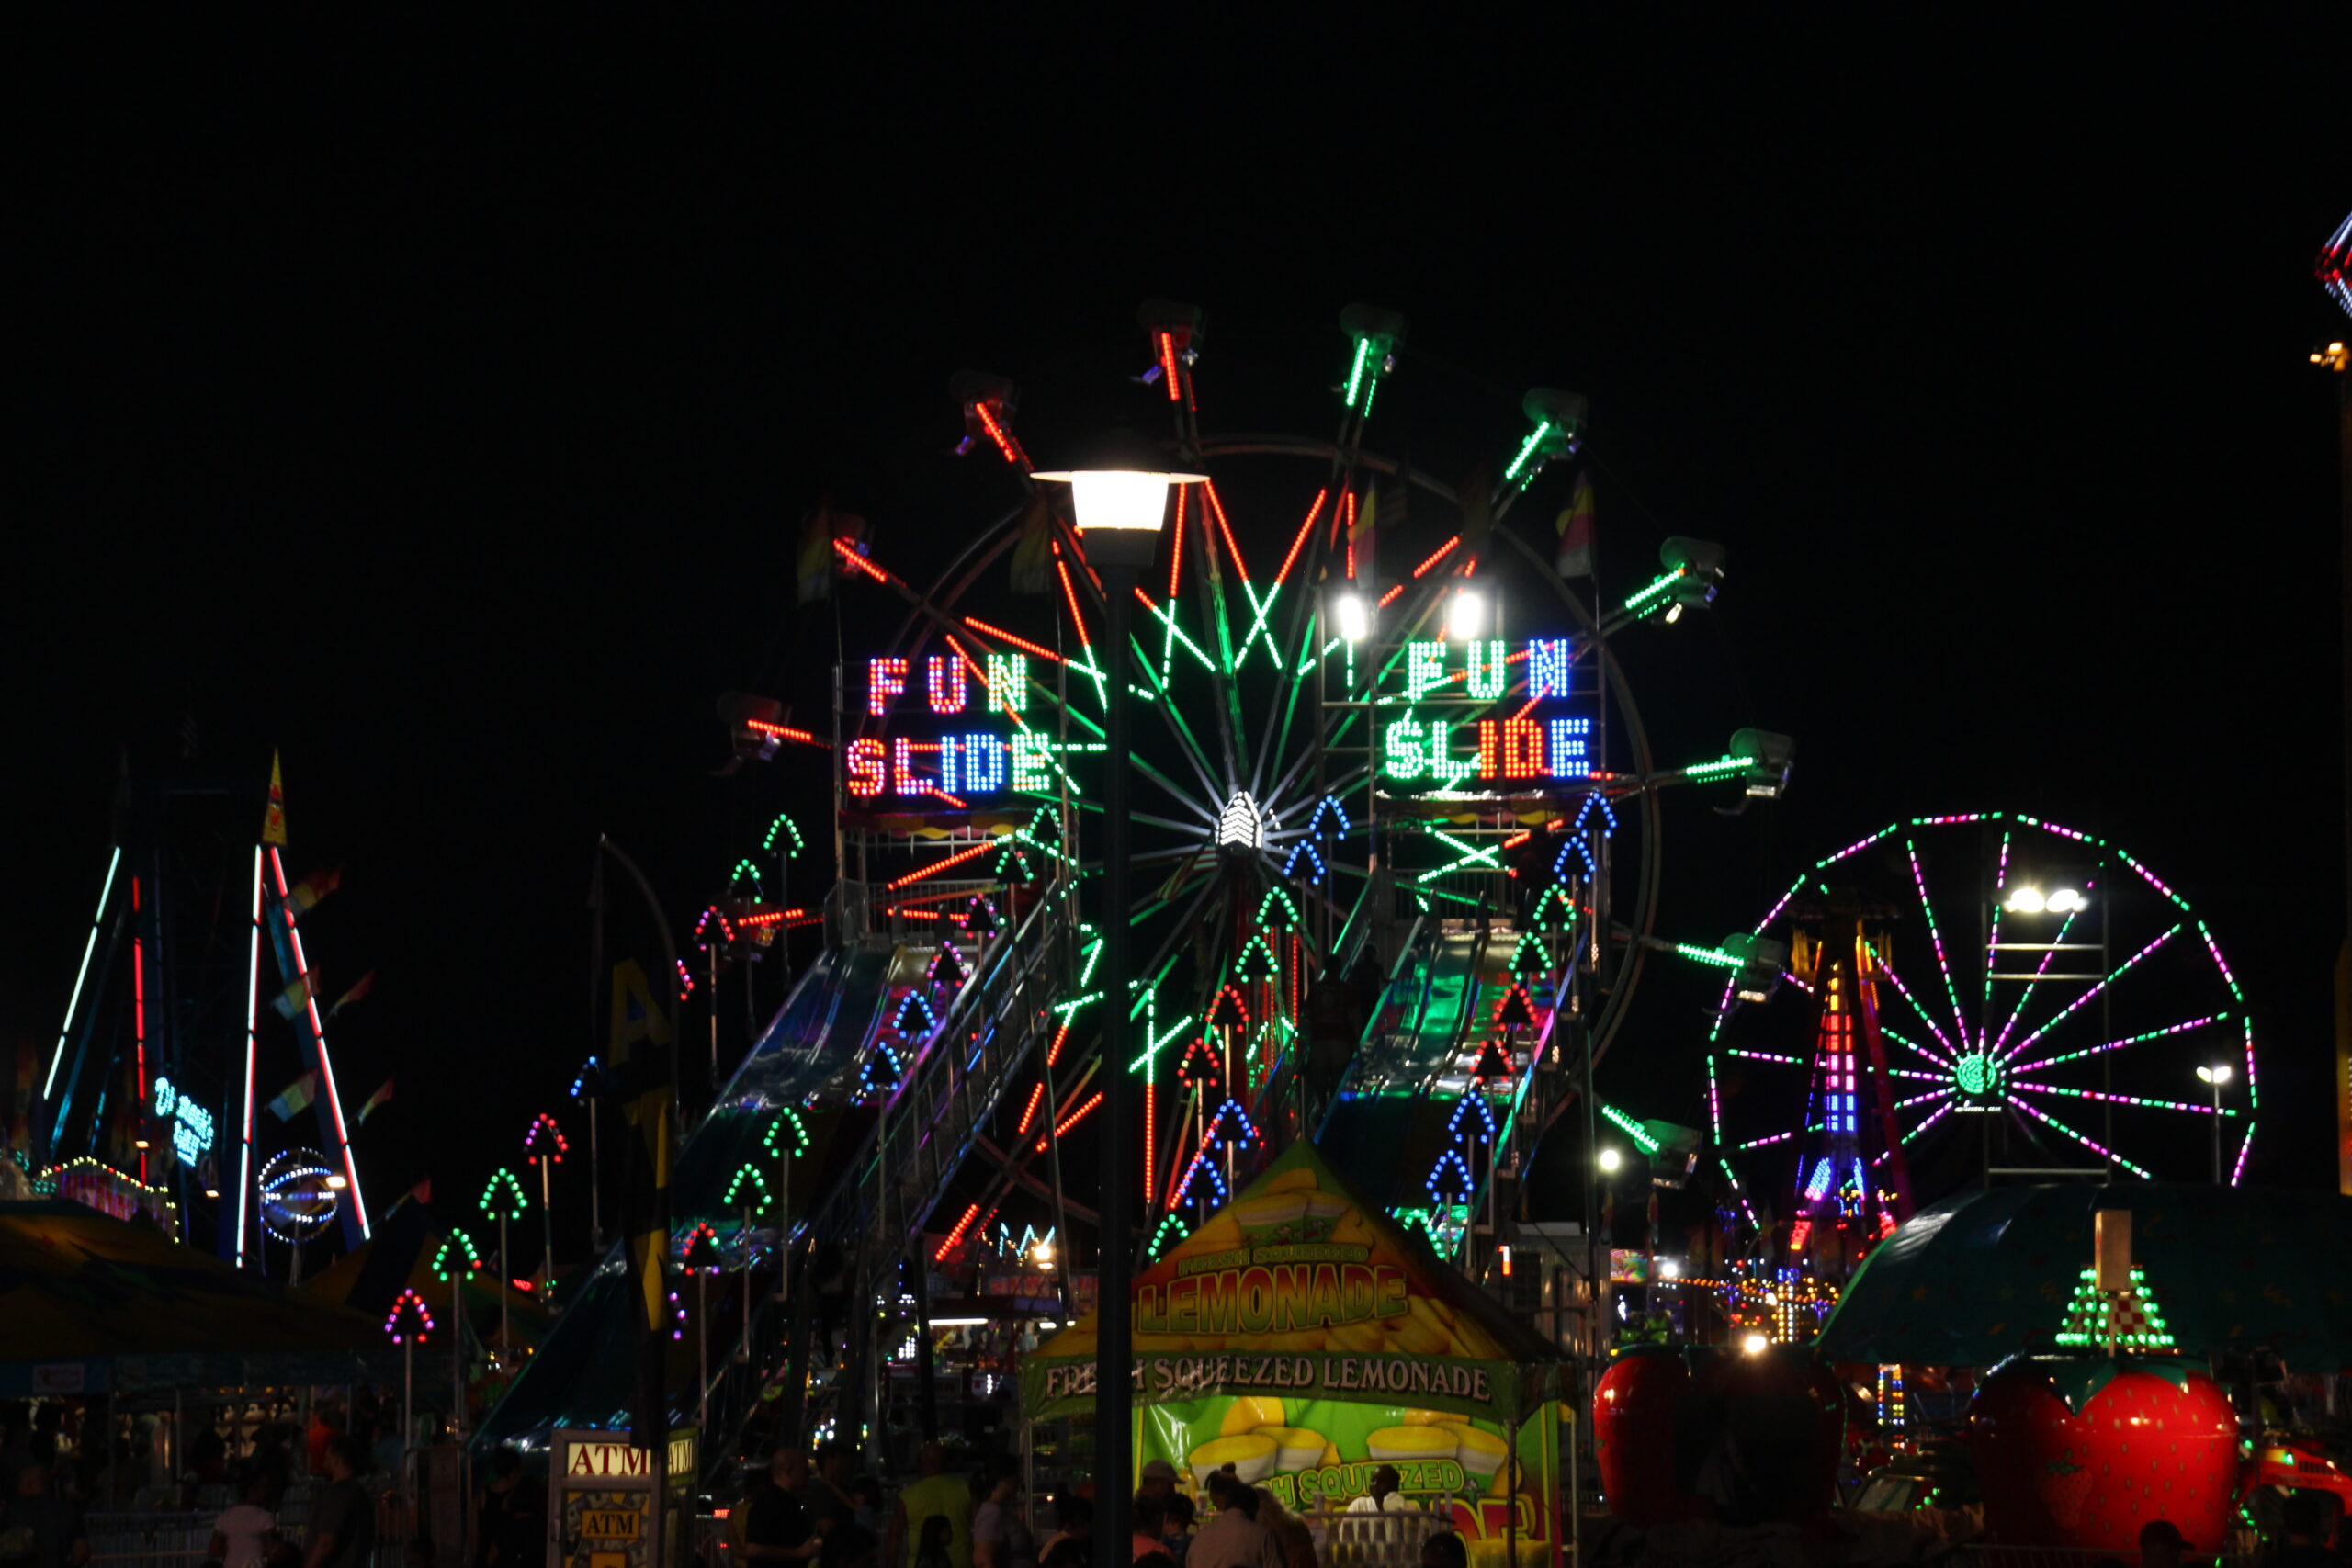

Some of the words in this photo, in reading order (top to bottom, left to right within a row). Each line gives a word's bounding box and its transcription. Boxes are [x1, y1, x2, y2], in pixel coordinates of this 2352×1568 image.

[869, 653, 1027, 715] FUN
[1408, 639, 1567, 700] FUN
[848, 734, 1050, 795] SLIDE
[1386, 718, 1589, 779] SLIDE
[1137, 1262, 1408, 1334] LEMONADE
[1046, 1359, 1146, 1399] FREH
[1153, 1355, 1314, 1390] SQUEEZED
[1322, 1357, 1492, 1403] LEMONADE
[570, 1443, 647, 1474] ATM
[668, 1439, 693, 1476] ATM
[1298, 1460, 1464, 1502] SQUZED
[586, 1514, 633, 1535] ATM
